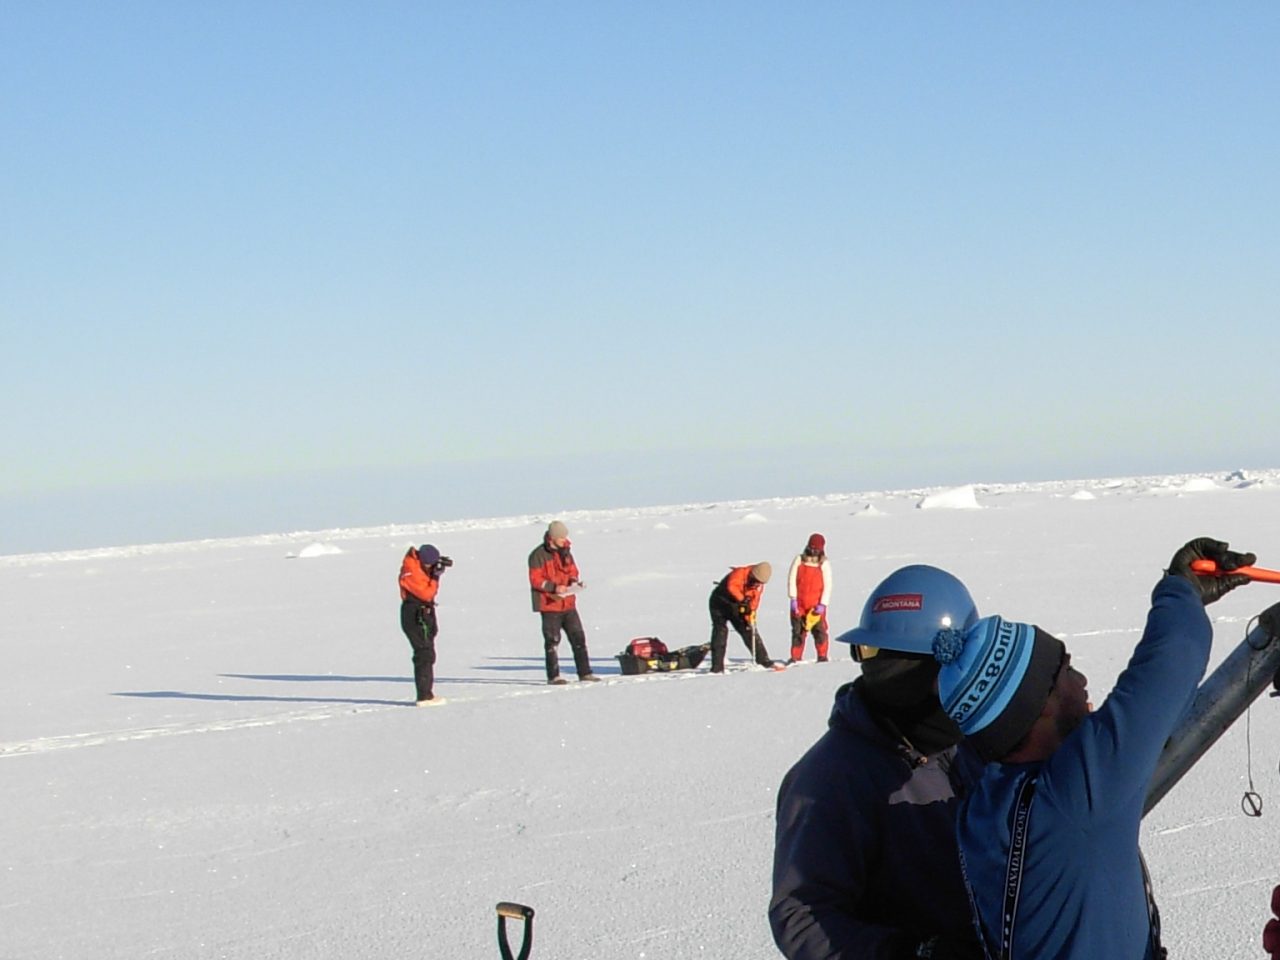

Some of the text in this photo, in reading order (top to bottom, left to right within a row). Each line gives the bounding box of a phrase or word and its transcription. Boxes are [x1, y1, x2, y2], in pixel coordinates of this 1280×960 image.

[881, 600, 921, 609] MONTANA
[952, 619, 1014, 721] patagonia
[1008, 850, 1021, 898] CANADA
